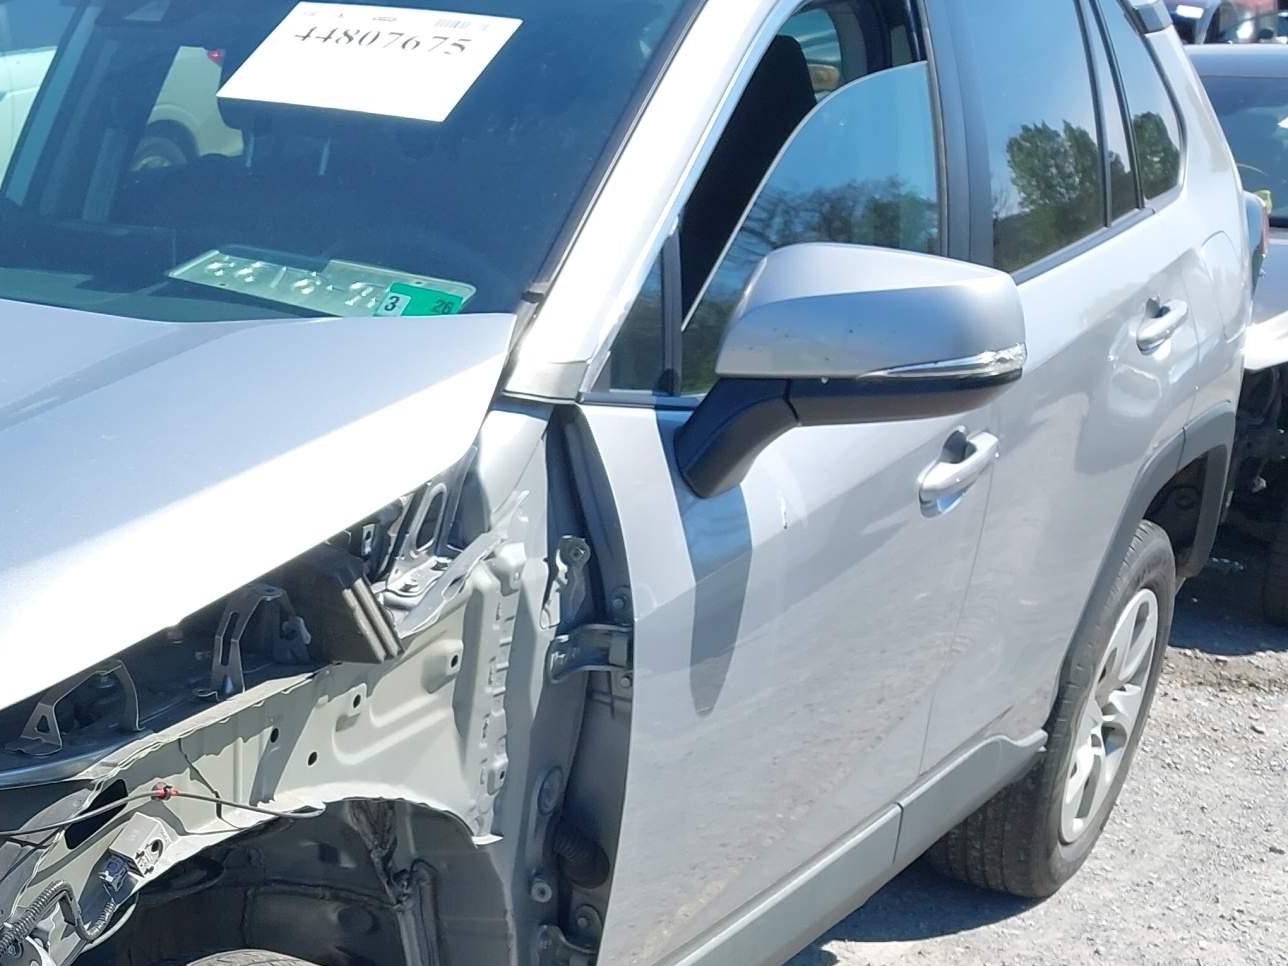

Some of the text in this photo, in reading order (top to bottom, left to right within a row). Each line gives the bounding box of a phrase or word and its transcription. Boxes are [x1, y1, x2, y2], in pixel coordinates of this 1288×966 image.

[294, 25, 472, 55] 44807675
[384, 296, 400, 311] 3
[432, 299, 455, 314] 26
